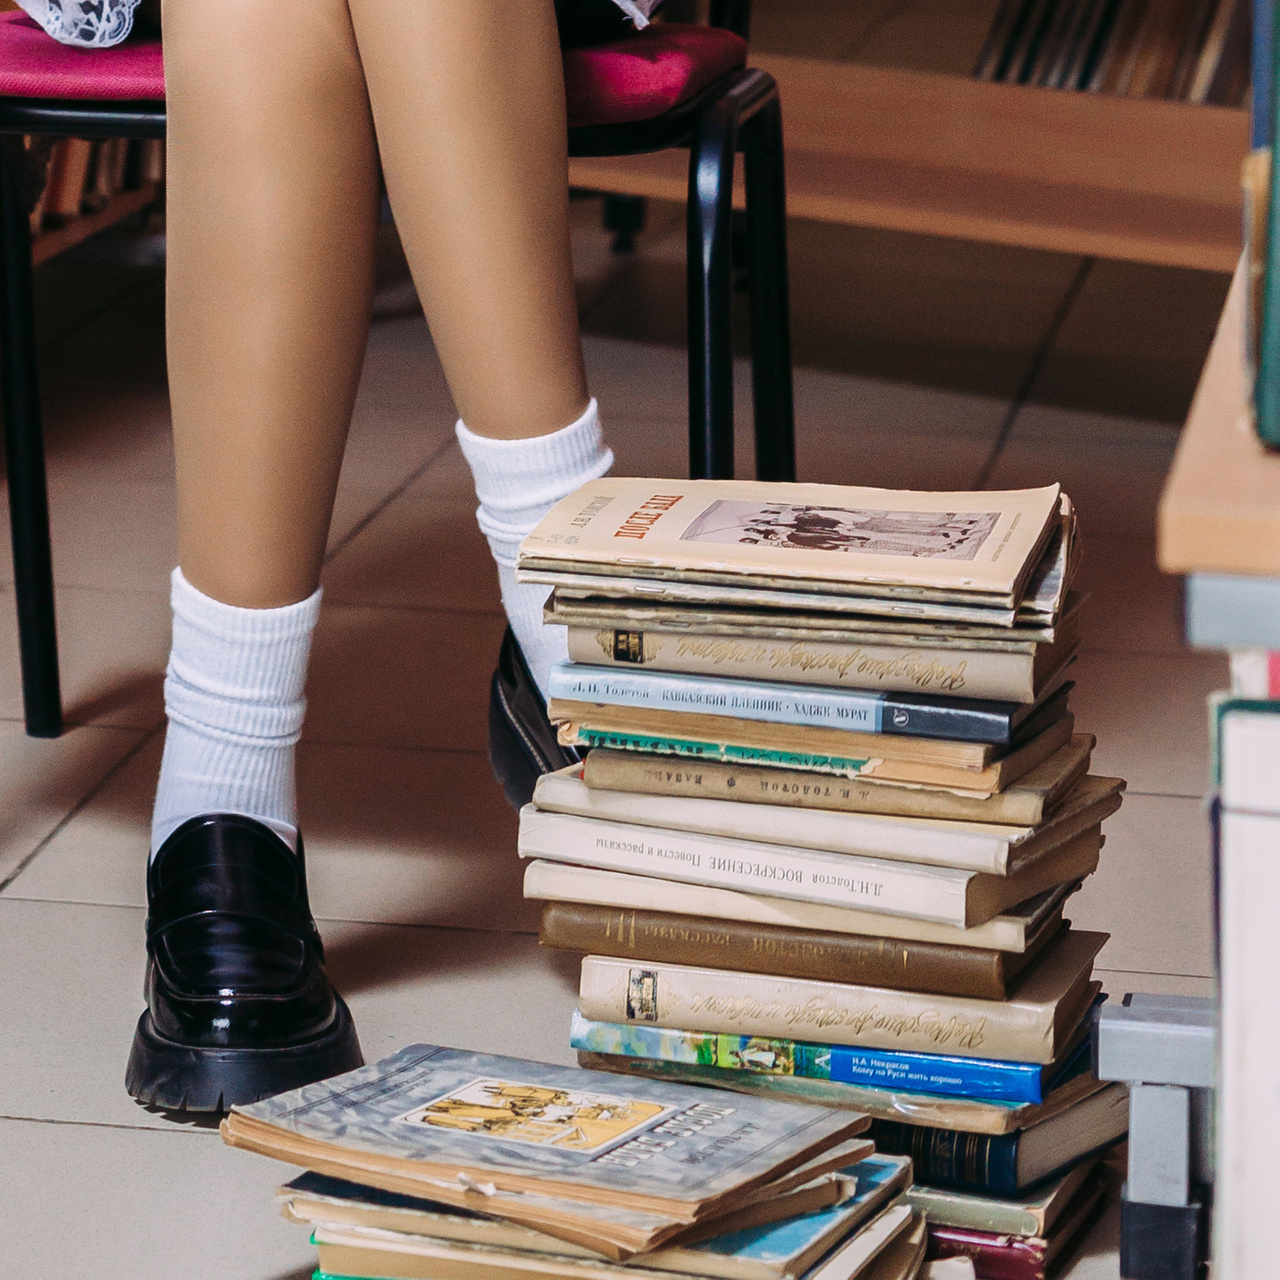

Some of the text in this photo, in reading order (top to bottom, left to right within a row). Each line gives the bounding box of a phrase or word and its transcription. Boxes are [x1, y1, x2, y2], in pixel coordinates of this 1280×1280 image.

[613, 510, 664, 540] ПОСЛЕ
[661, 690, 727, 708] КАВКАЗСКИЙ
[729, 694, 783, 713] ПЛЕННИК
[595, 837, 645, 856] рассказы
[647, 846, 656, 857] и
[656, 848, 702, 867] Повести
[709, 856, 804, 883] ВОСКРЕСЕНИЕ
[870, 1057, 910, 1072] Некрасов
[851, 1065, 873, 1077] Кому
[886, 1068, 905, 1080] Руси
[907, 1072, 928, 1082] жить
[929, 1075, 963, 1085] хорошо
